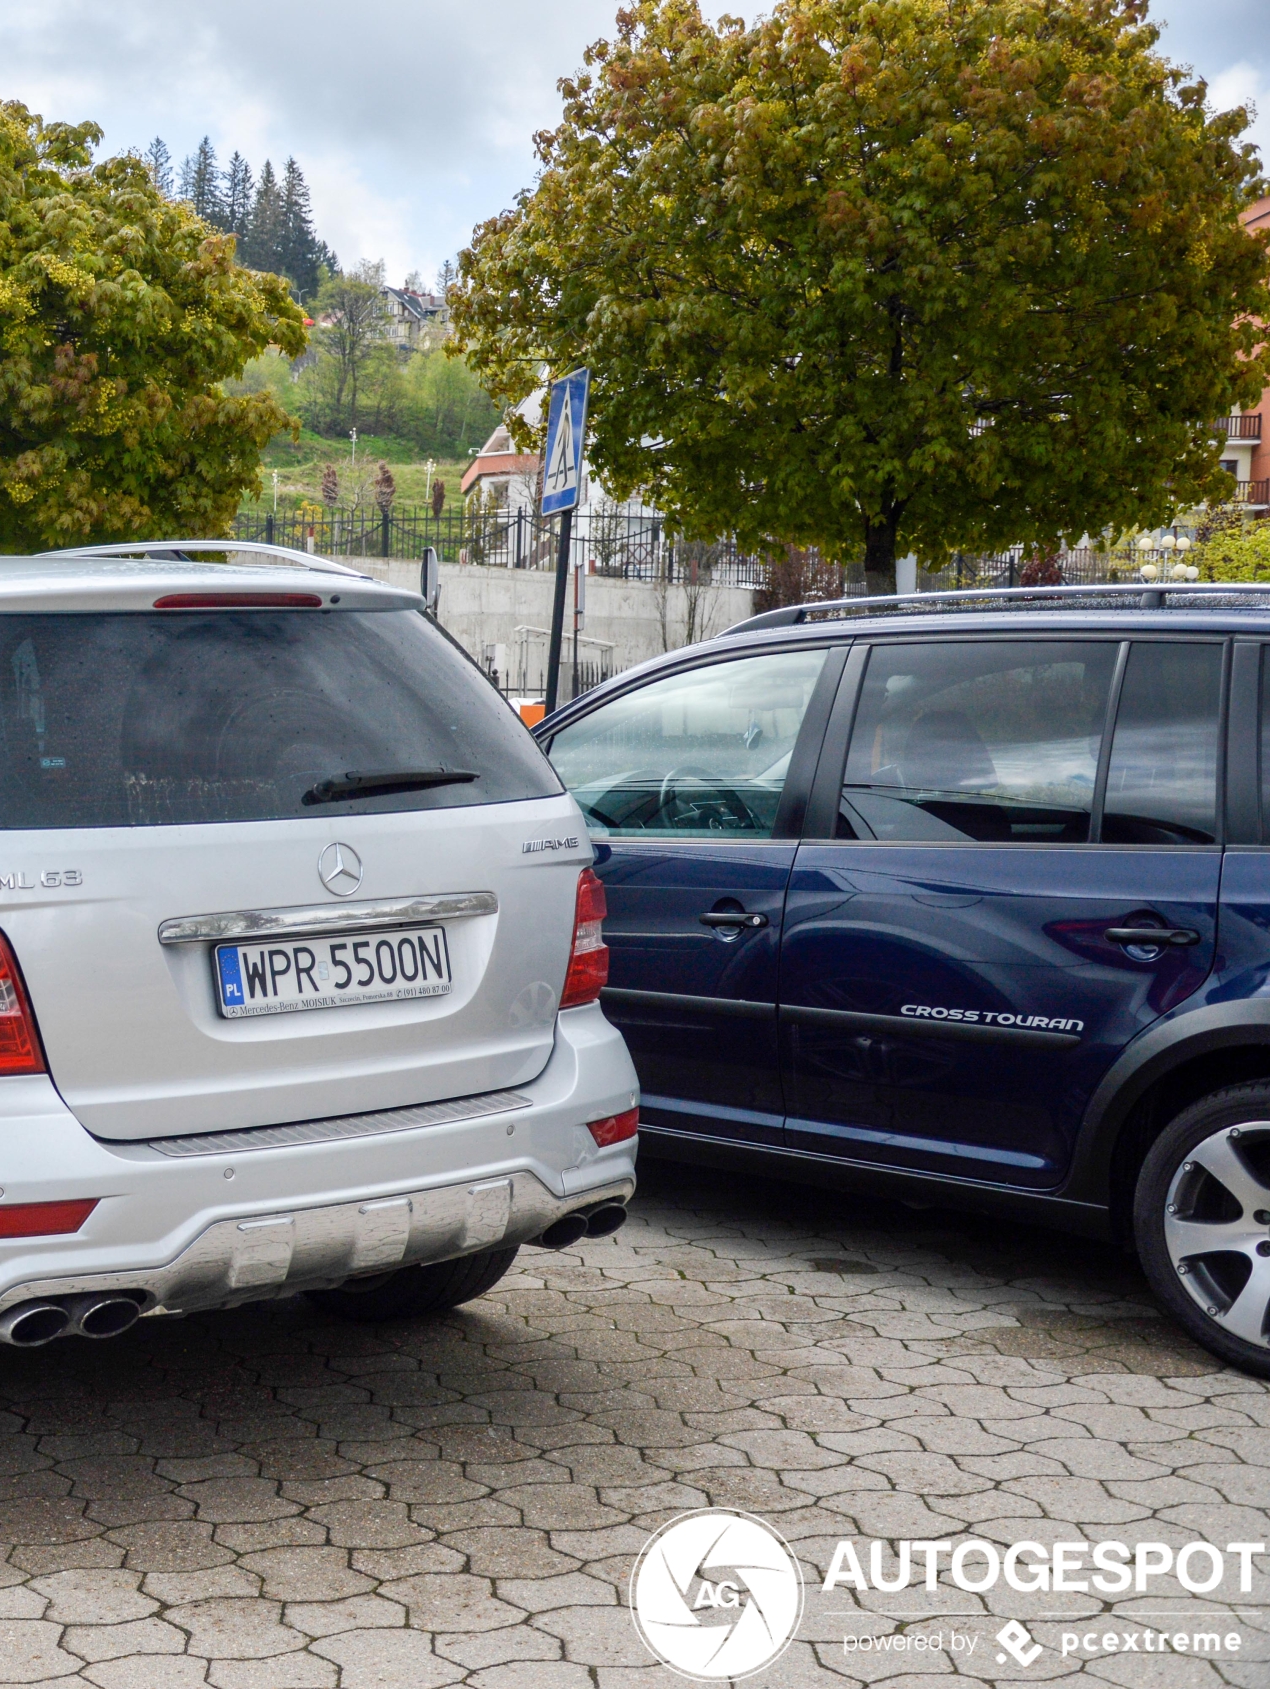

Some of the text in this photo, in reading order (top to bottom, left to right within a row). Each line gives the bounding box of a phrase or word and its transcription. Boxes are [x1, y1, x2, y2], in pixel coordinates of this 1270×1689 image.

[40, 870, 83, 888] 63
[242, 934, 443, 998] WPR 5500N
[226, 983, 241, 997] PL
[240, 1002, 299, 1015] Mercedes-Benz
[403, 988, 417, 998] (91)
[418, 987, 431, 996] 480
[432, 986, 440, 994] 87
[441, 984, 450, 992] 00
